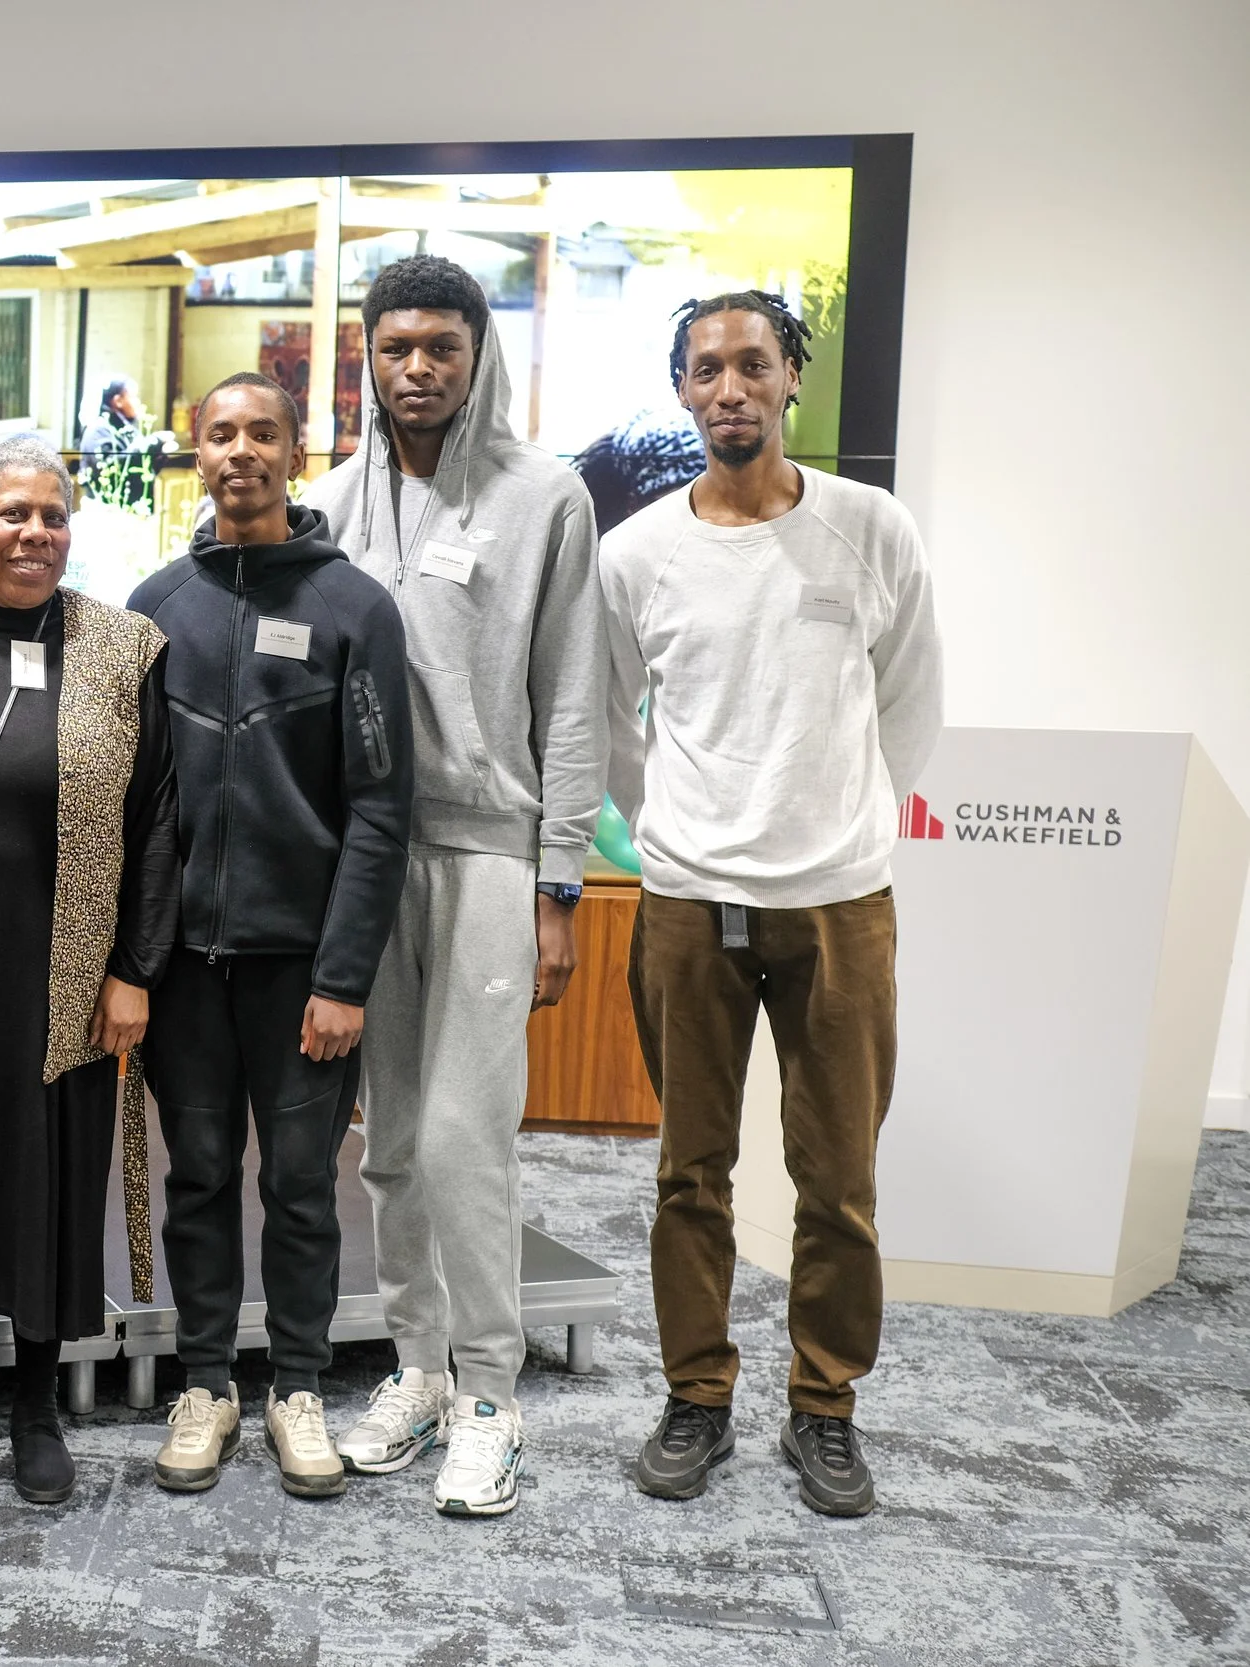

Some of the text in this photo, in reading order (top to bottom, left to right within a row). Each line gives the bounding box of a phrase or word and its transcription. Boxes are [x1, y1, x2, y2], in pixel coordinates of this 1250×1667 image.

[956, 803, 1121, 825] CUSHMAN &
[955, 824, 1122, 846] WAKEFIELD
[489, 977, 511, 989] NIKE
